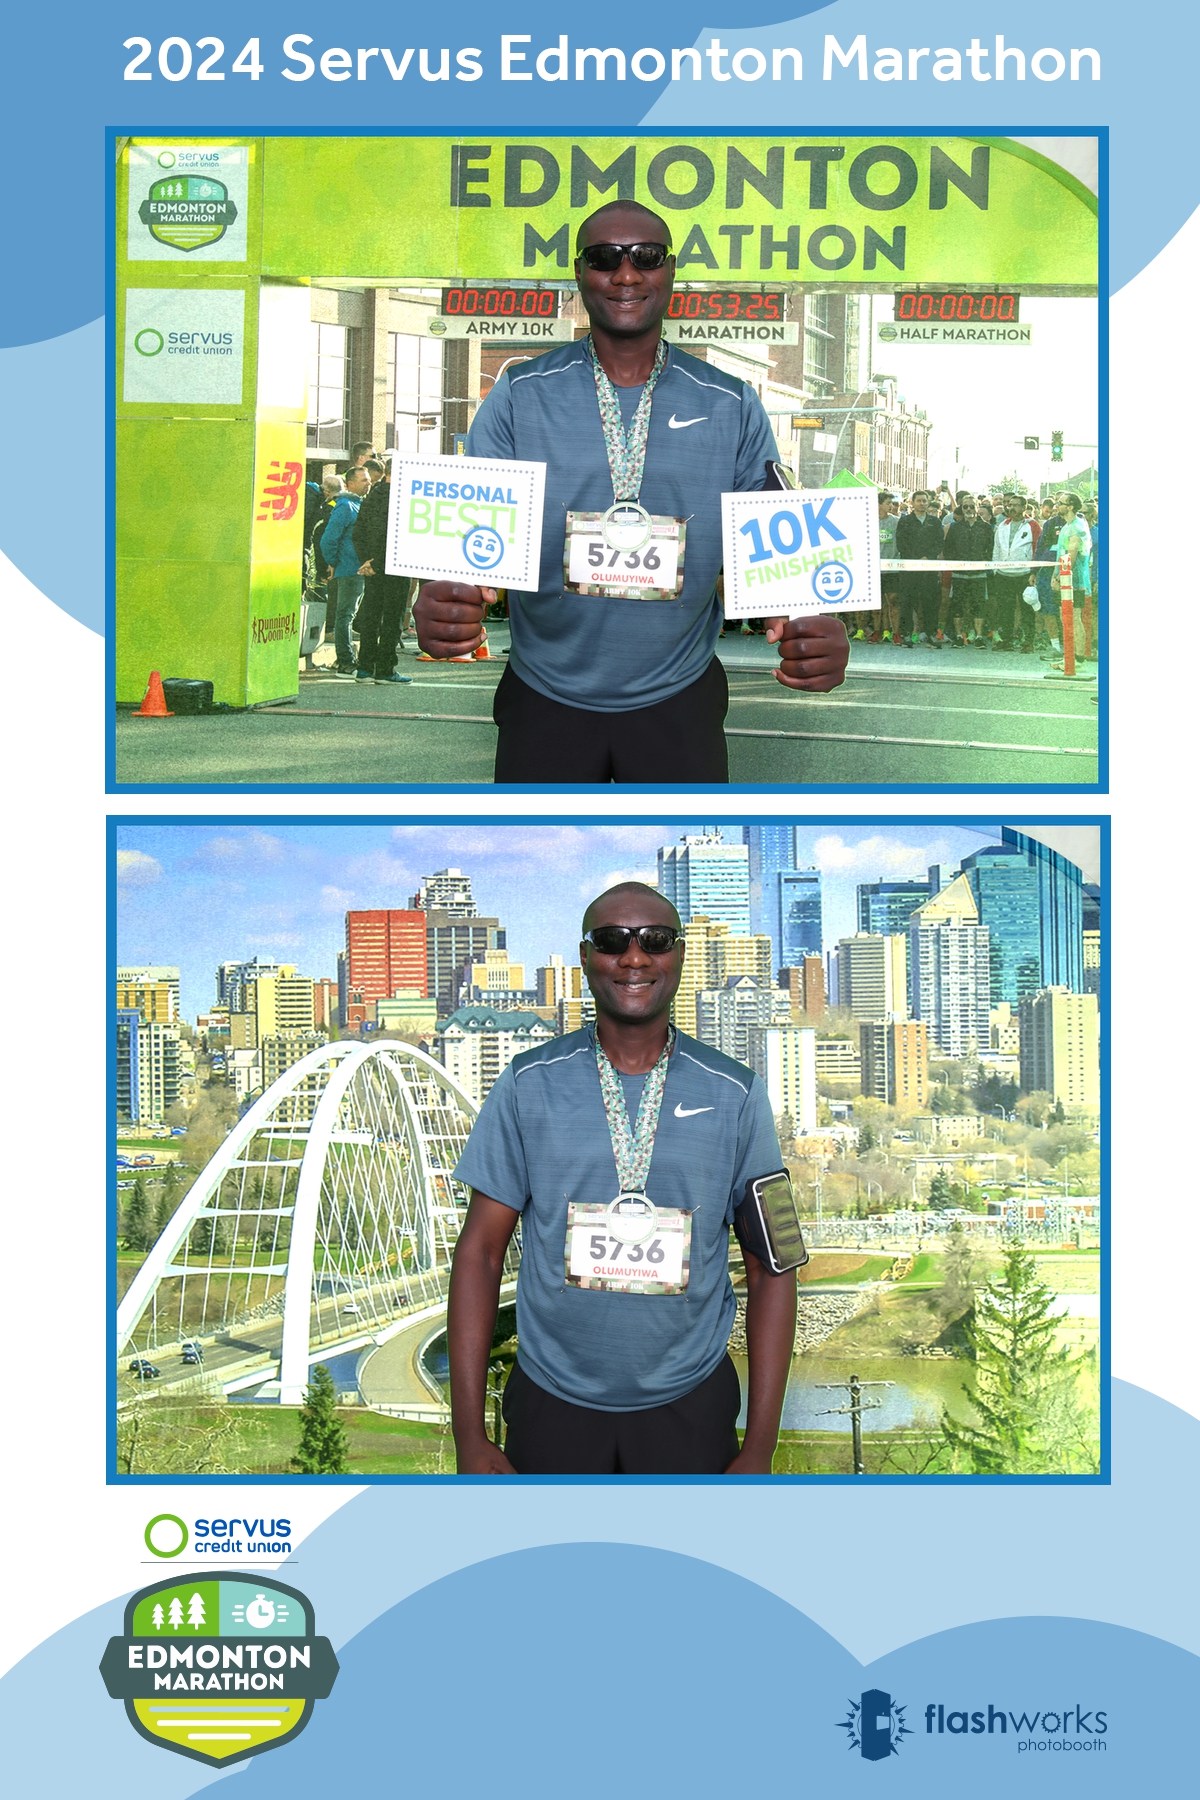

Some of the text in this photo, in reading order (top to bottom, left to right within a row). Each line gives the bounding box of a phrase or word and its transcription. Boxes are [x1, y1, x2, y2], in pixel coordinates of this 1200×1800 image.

[178, 152, 220, 161] servus
[450, 144, 991, 211] EDMONTON
[149, 202, 227, 214] EDMONTON
[160, 214, 215, 222] MARATHON
[524, 222, 907, 271] MATHON
[466, 321, 554, 336] ARMY 10K
[679, 325, 785, 340] MARATHON
[900, 328, 939, 340] HALF
[943, 328, 1031, 340] MARATHON
[168, 332, 233, 345] servus
[168, 345, 232, 355] credit union
[411, 480, 518, 505] PERSONAL
[408, 498, 517, 544] BEST!
[739, 496, 848, 564] 10K
[587, 542, 661, 571] 5736
[744, 544, 854, 588] FINISHER!
[591, 573, 655, 584] OLUMUYIWA
[589, 1235, 665, 1264] 5736
[593, 1266, 659, 1278] OLUMUYIWA
